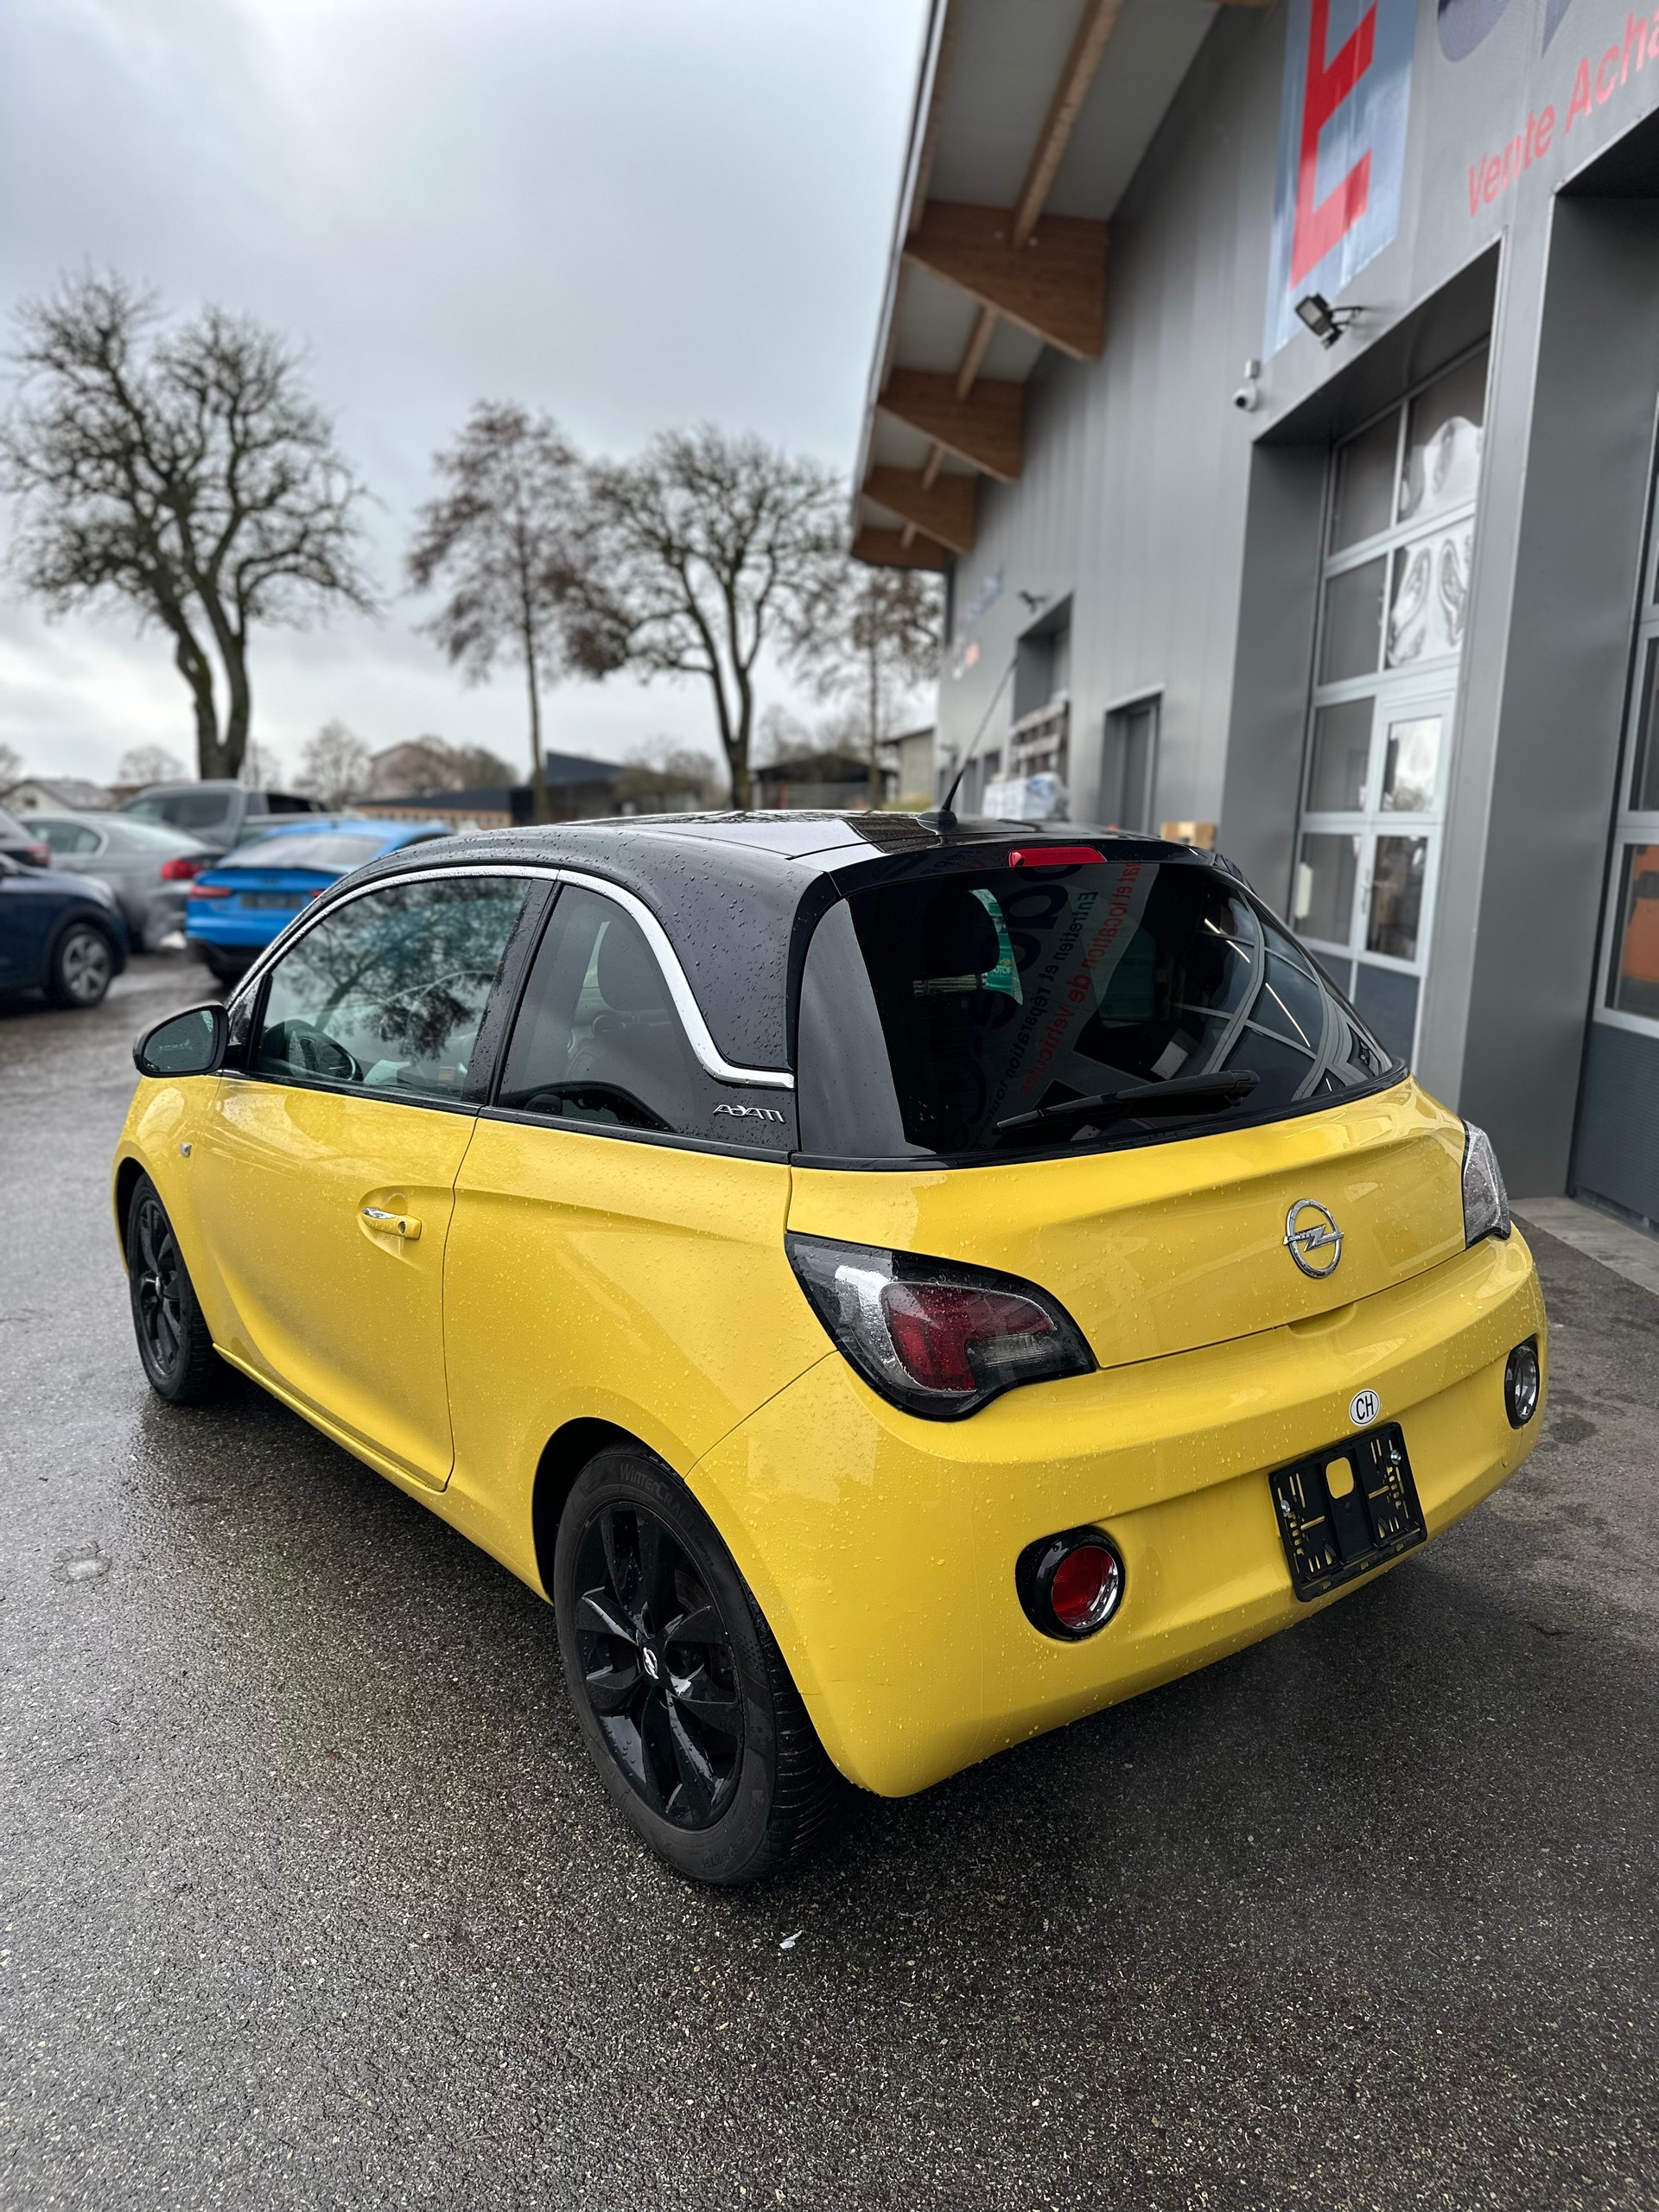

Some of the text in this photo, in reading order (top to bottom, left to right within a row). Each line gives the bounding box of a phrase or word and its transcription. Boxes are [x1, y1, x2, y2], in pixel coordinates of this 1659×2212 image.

[1468, 104, 1555, 217] Vente
[713, 1104, 785, 1122] ADAM
[1357, 1394, 1374, 1420] CH
